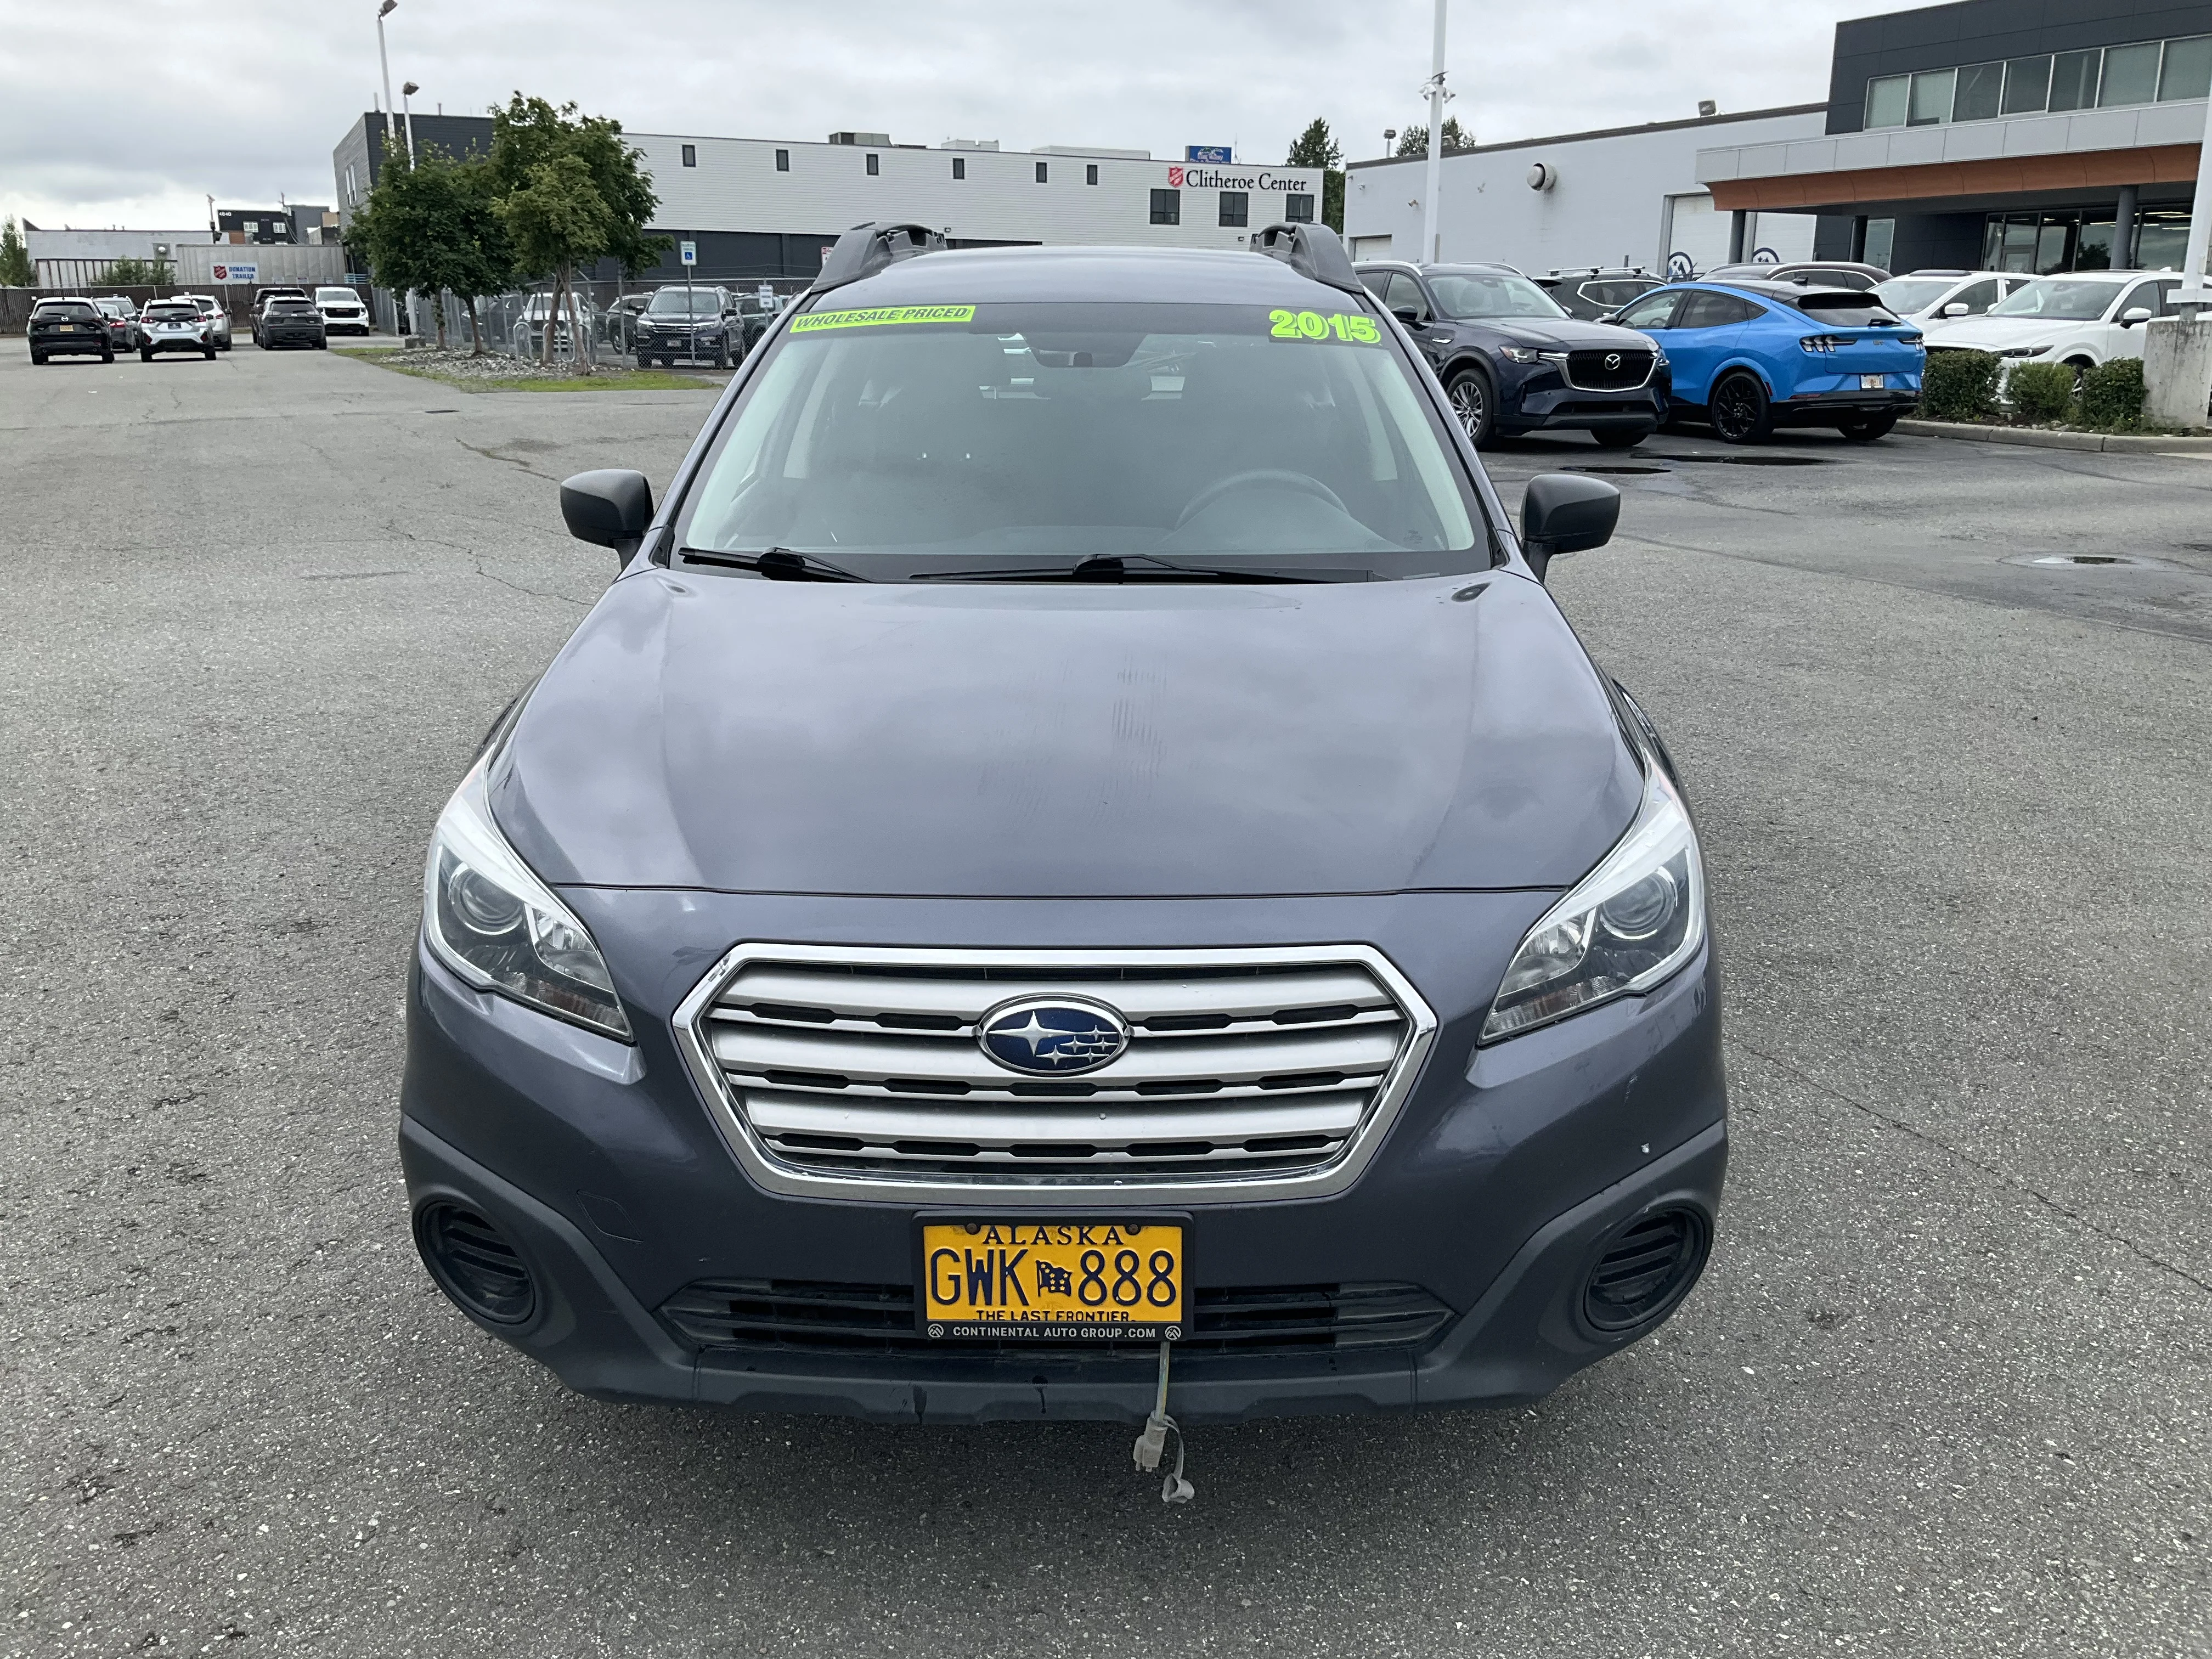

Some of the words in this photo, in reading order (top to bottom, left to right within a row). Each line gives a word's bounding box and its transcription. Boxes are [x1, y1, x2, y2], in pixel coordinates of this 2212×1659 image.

[1186, 170, 1254, 189] Clitheroe
[1259, 173, 1307, 191] Center
[795, 309, 901, 329] WHOLESALE
[902, 308, 970, 319] PRICED
[1269, 309, 1381, 343] 2015
[983, 1225, 1124, 1245] ALASKA
[930, 1248, 1030, 1306] GWK
[1078, 1249, 1176, 1307] 888
[977, 1310, 1005, 1321] THE
[1010, 1310, 1049, 1321] LAST
[952, 1327, 1040, 1338] CONTINENTAL
[1043, 1328, 1077, 1338] AUTO
